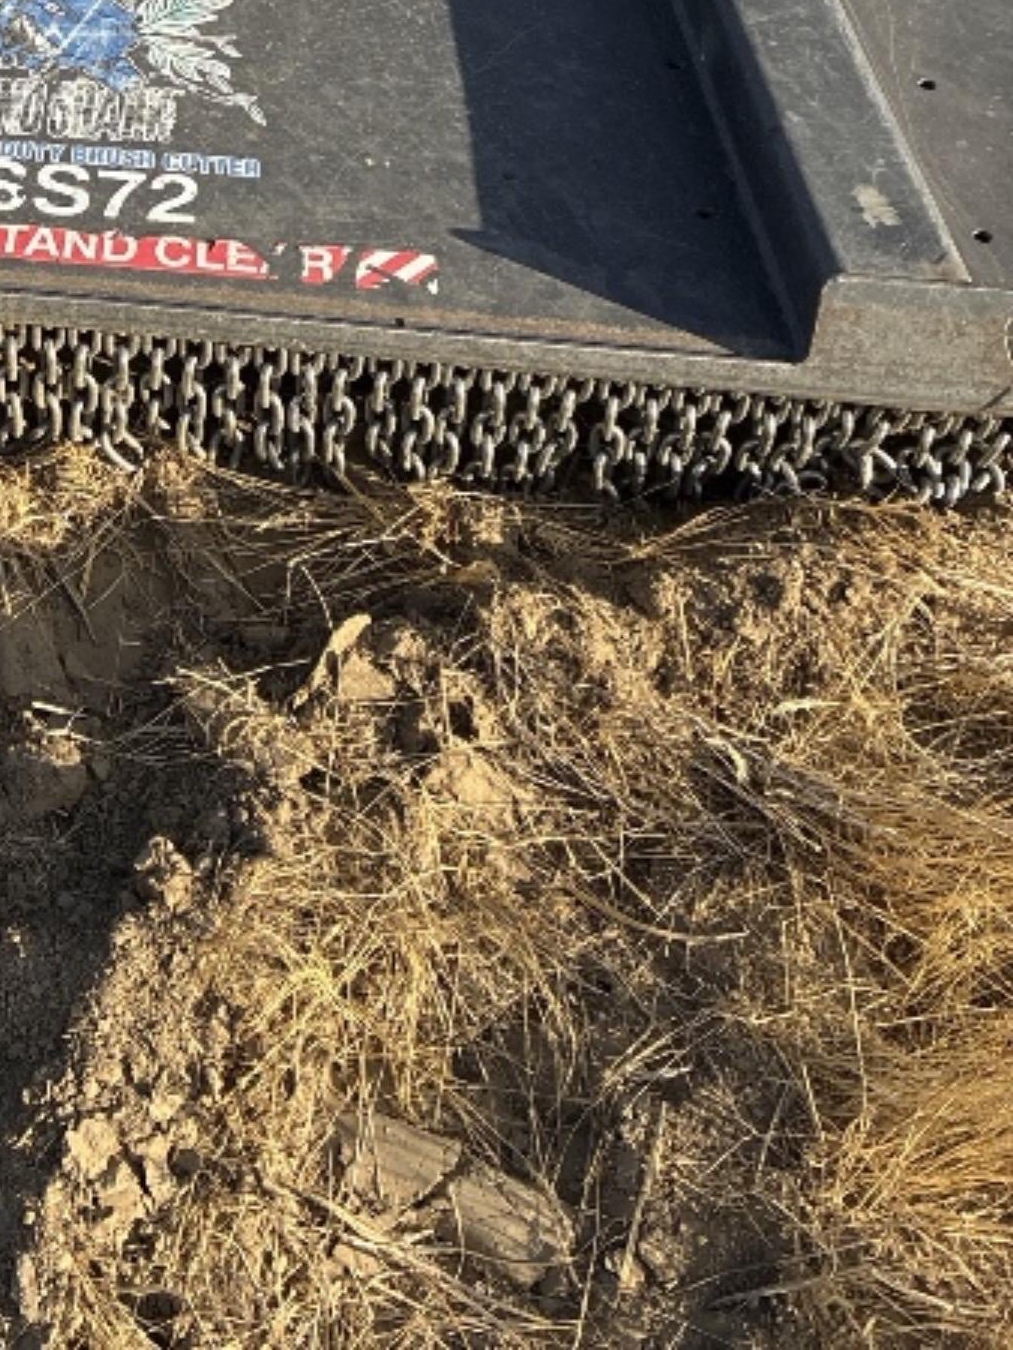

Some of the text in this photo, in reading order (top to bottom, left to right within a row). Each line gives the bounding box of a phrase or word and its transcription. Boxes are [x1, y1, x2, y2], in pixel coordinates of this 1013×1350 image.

[70, 144, 156, 170] BRUSH
[161, 151, 262, 179] CUTTER
[154, 235, 334, 283] CLER
